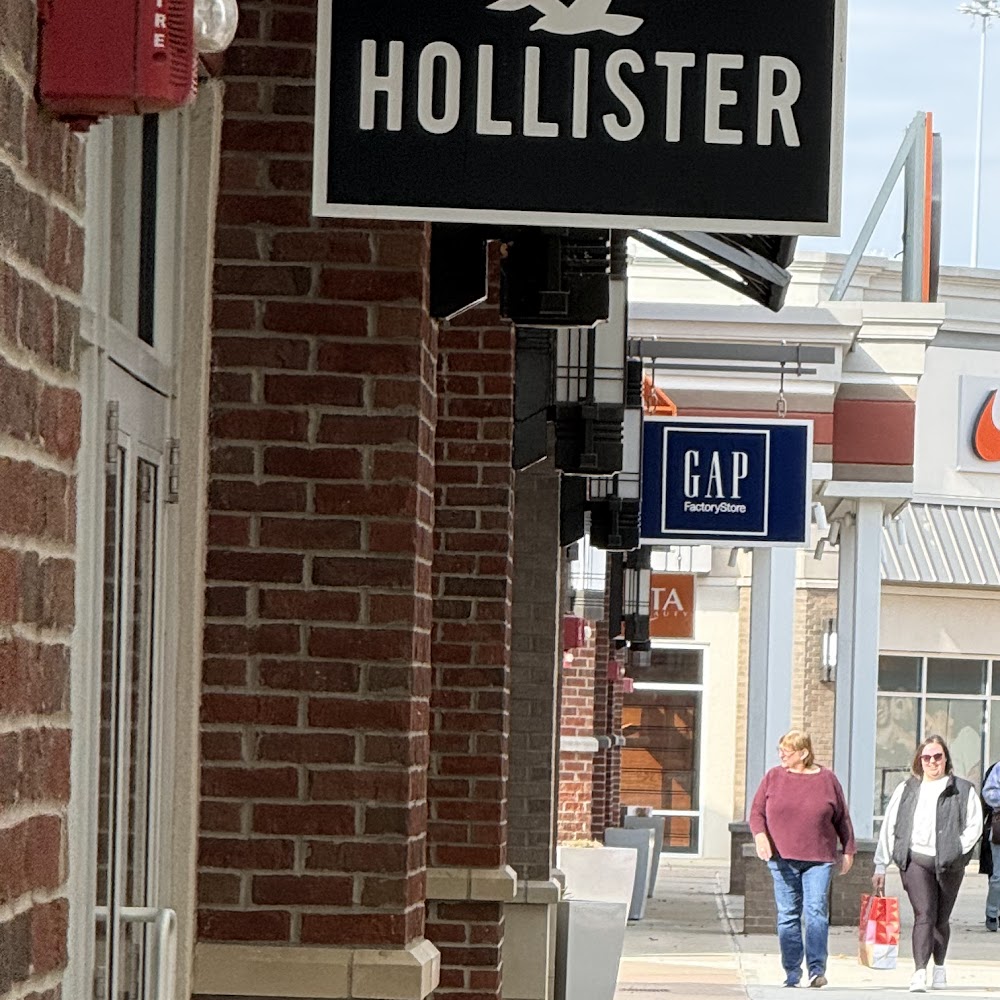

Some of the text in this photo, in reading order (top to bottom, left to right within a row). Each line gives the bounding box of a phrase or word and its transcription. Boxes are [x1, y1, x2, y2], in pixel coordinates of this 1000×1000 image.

[358, 37, 803, 149] HOLLISTER
[684, 449, 749, 500] GAP
[650, 587, 684, 611] TA
